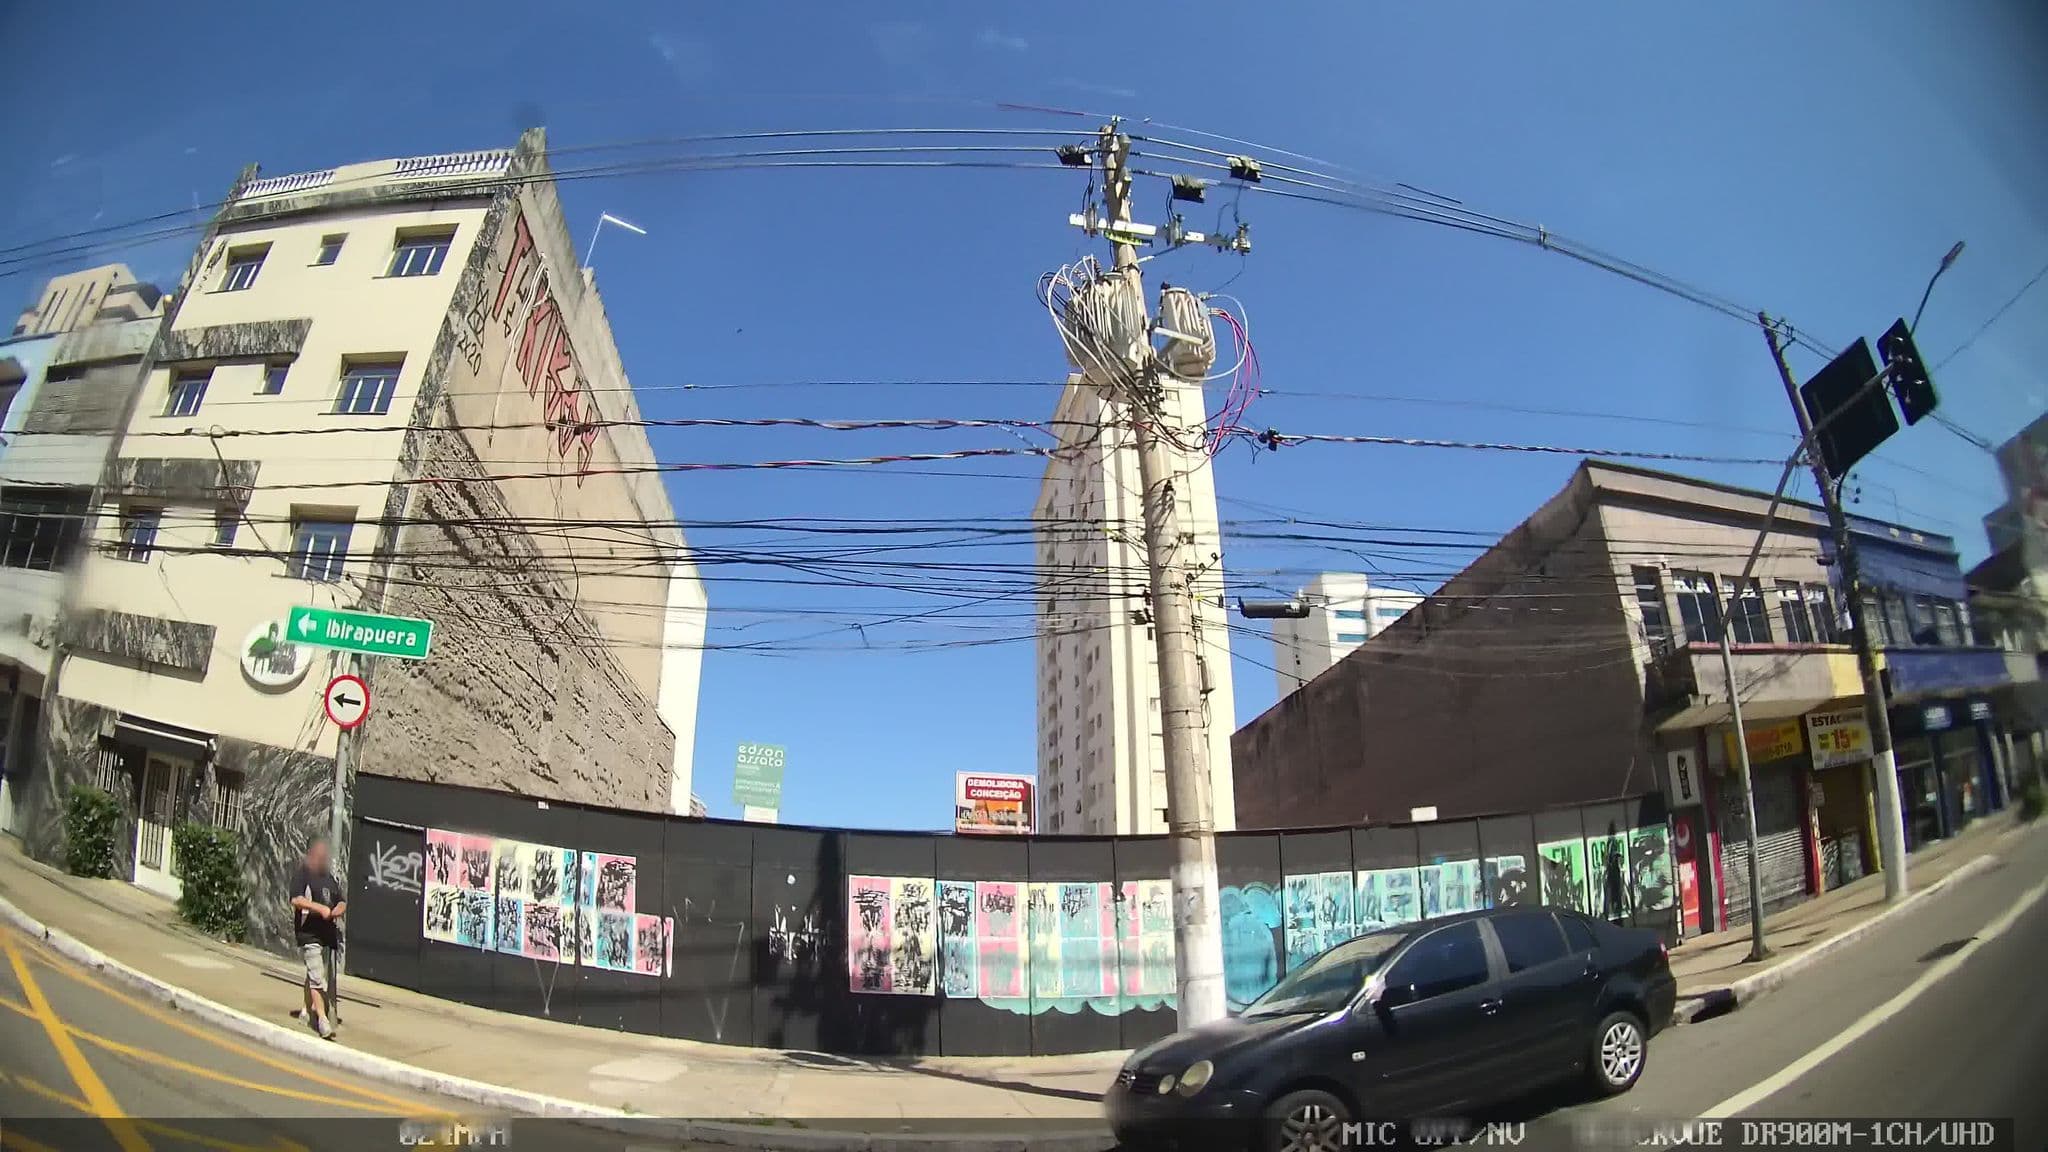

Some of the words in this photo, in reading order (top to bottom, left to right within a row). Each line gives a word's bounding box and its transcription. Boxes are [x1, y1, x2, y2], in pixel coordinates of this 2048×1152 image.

[326, 618, 417, 647] Ibirapuera
[738, 744, 784, 758] edson
[737, 754, 783, 767] assato
[967, 778, 1024, 789] DEMOLIDORA
[970, 789, 1021, 799] CONCEIÇÃO
